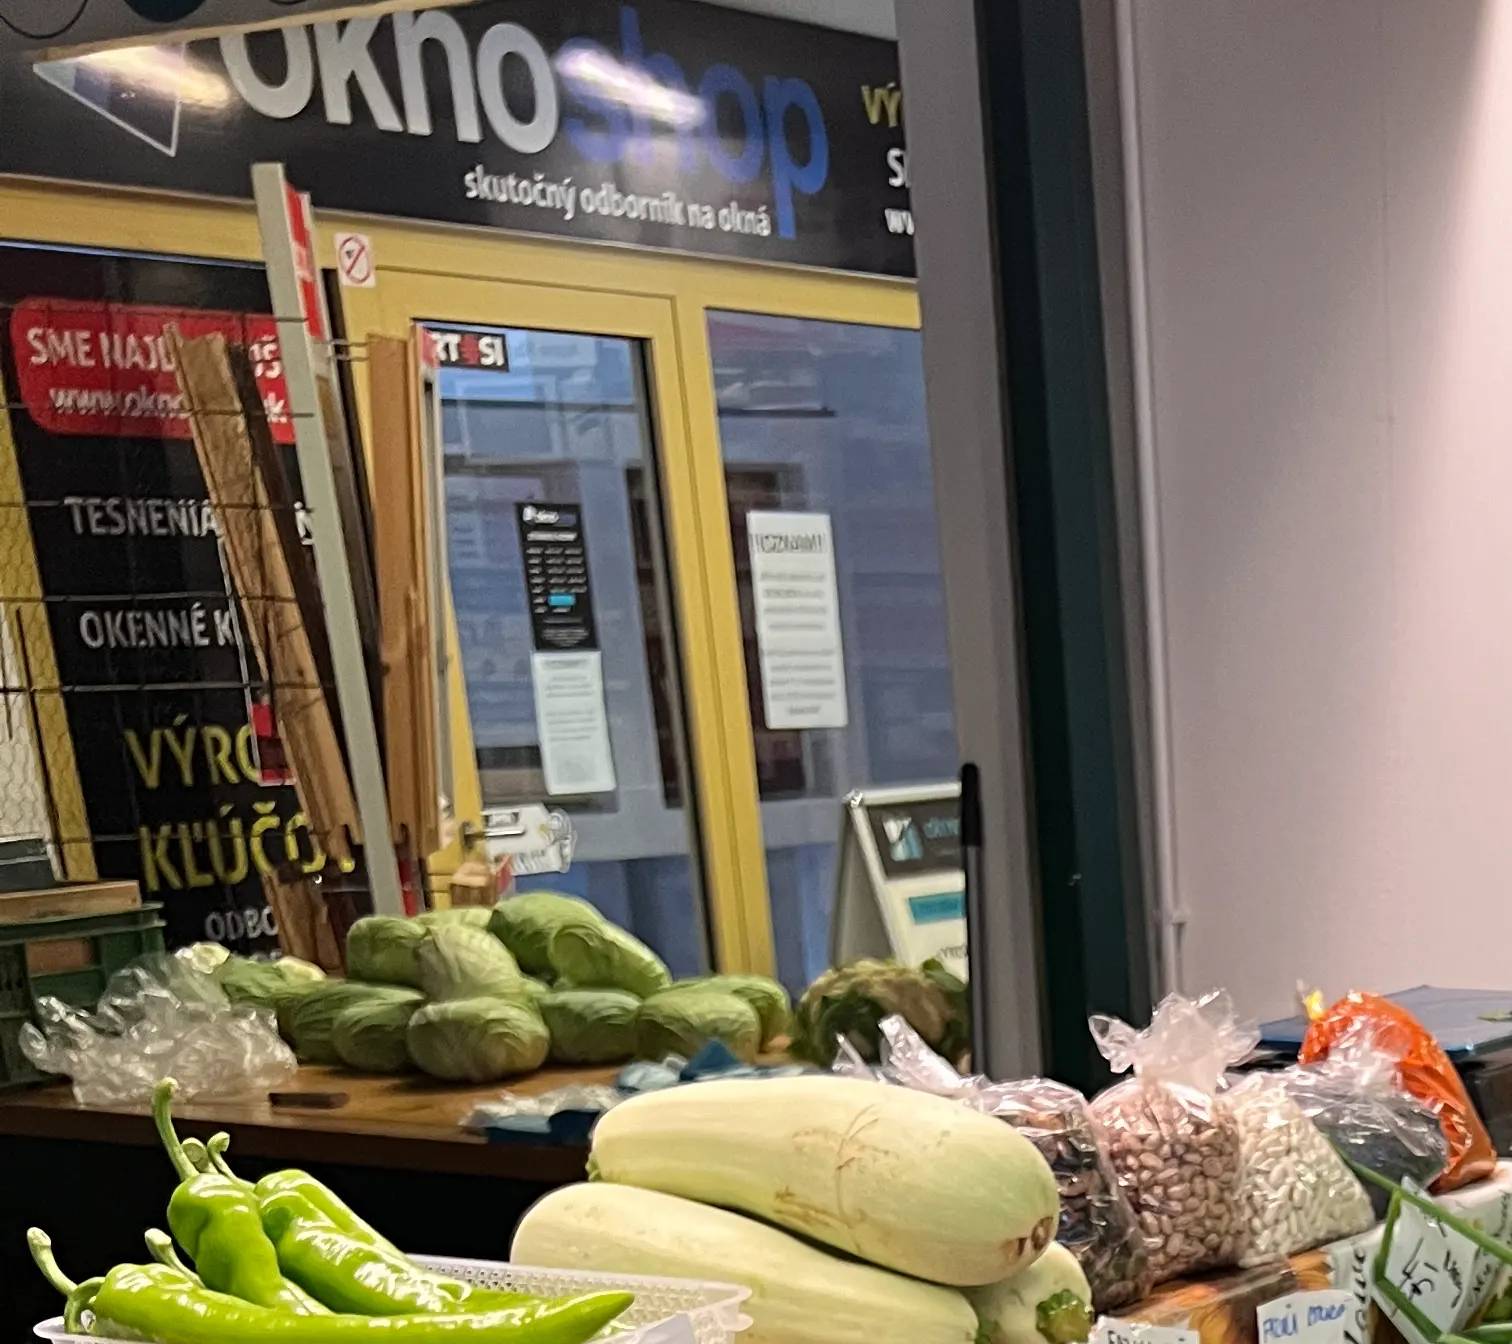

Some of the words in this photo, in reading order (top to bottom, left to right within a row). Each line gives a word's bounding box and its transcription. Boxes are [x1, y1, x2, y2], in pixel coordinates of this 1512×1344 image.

[464, 163, 576, 221] skutočný
[688, 202, 717, 230] na
[27, 326, 96, 368] SME
